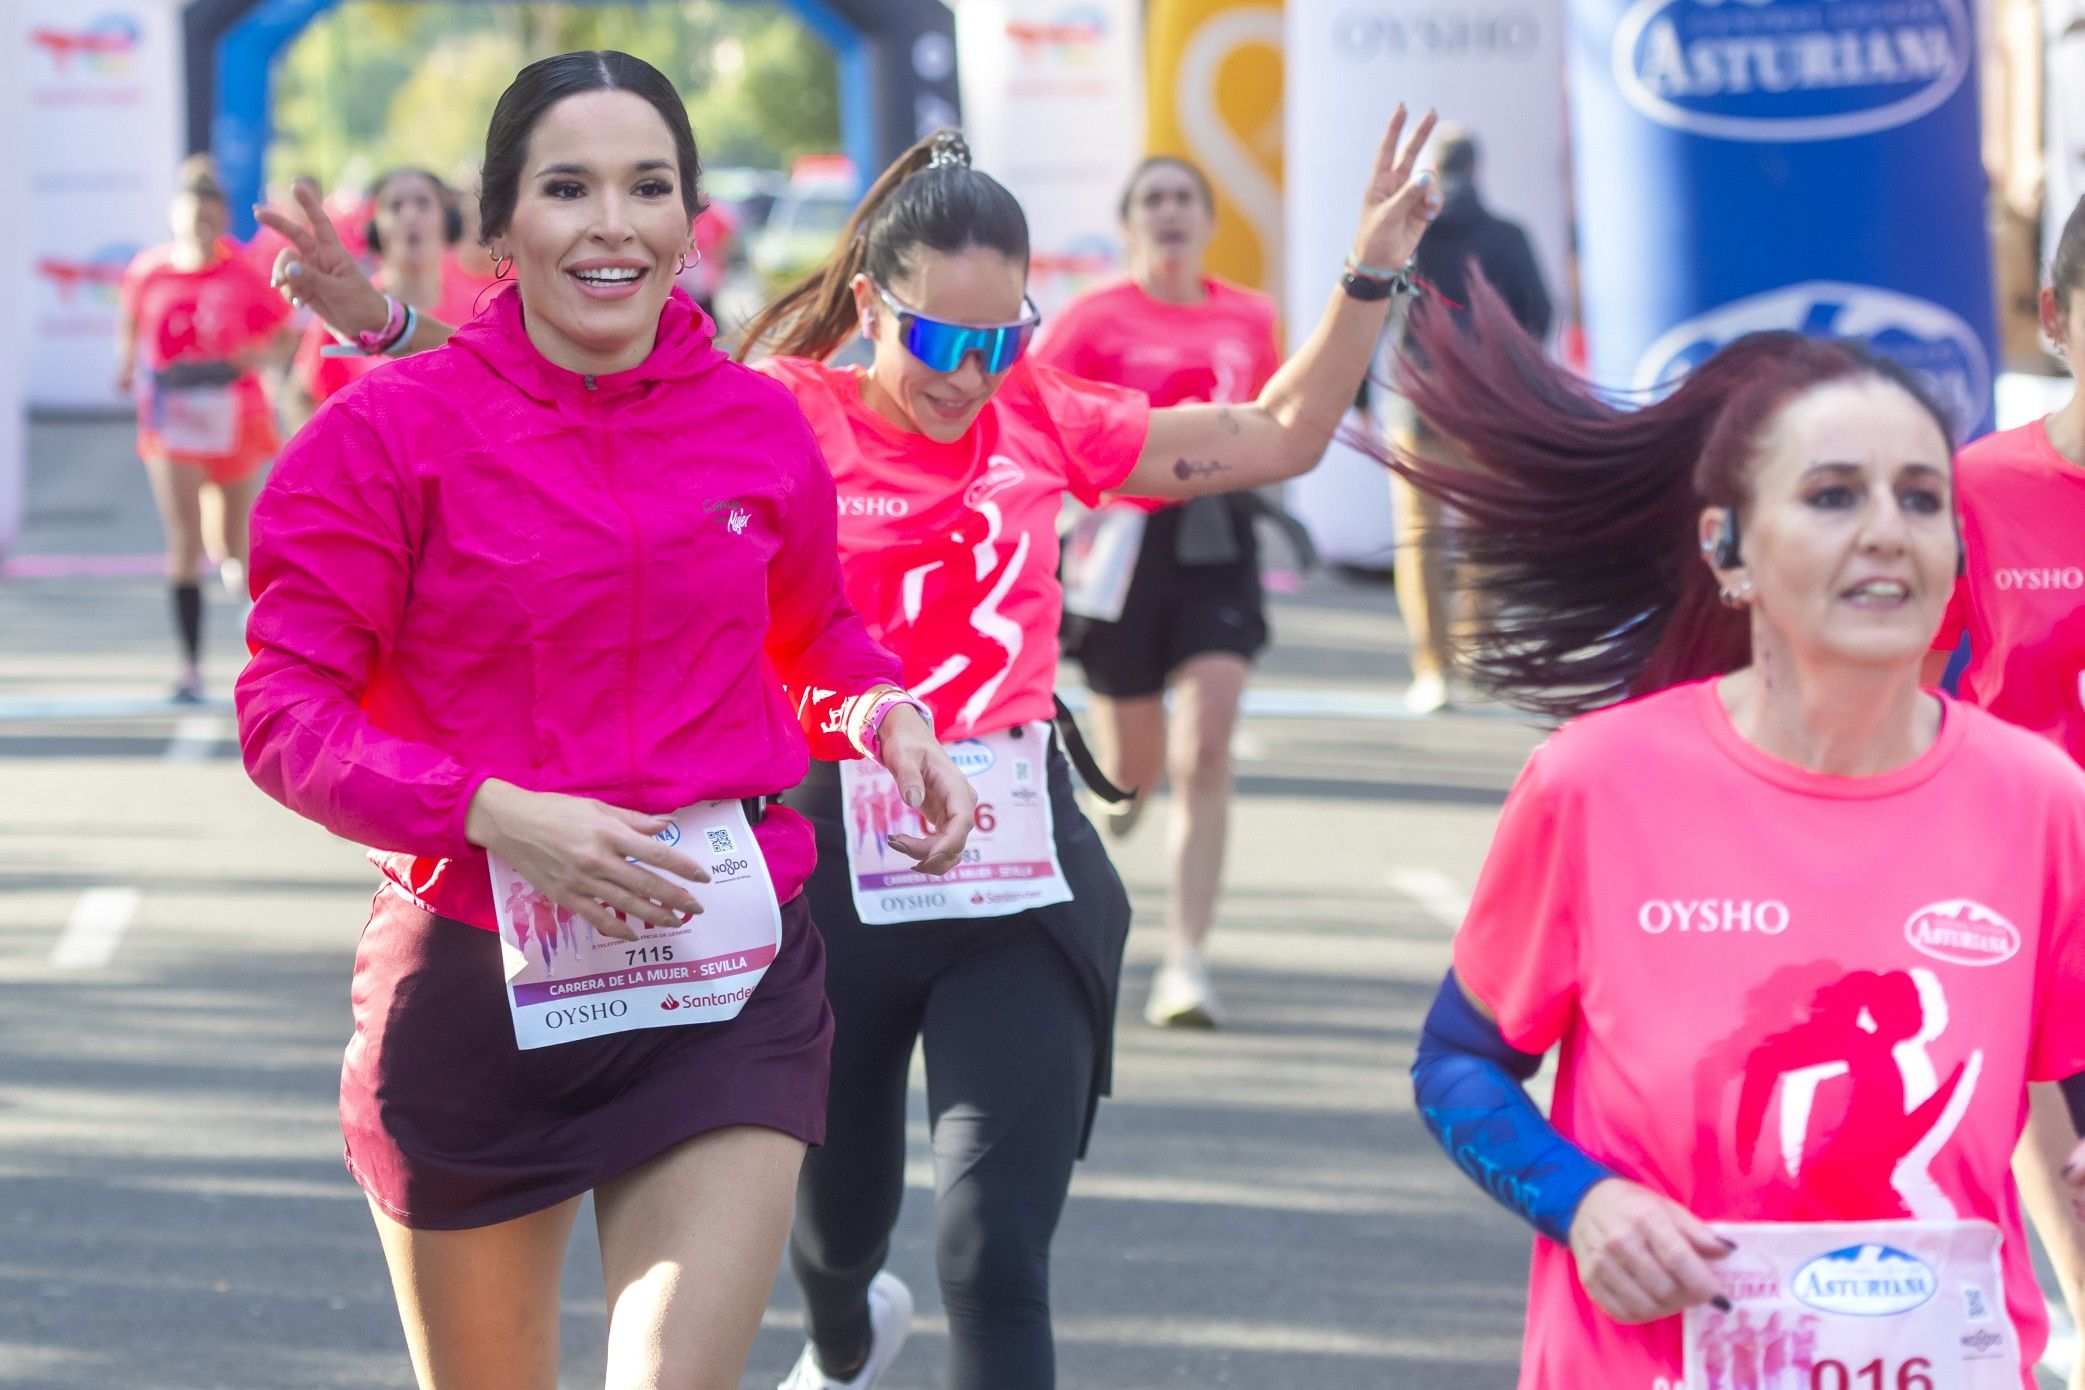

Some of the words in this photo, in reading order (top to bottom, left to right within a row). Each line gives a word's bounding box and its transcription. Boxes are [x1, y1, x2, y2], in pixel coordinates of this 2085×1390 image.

[836, 496, 909, 517] YSHO
[1993, 566, 2084, 590] OYSHO
[881, 893, 946, 912] OYSHO
[1638, 898, 1790, 934] OYSHO
[625, 945, 674, 966] 7115
[549, 978, 606, 995] CARRERA
[608, 975, 625, 987] DE
[628, 971, 644, 984] LA
[647, 967, 690, 981] MUJER
[700, 957, 748, 976] SEVILLA
[545, 999, 627, 1029] OYSHO
[1811, 1356, 1934, 1390] 016
